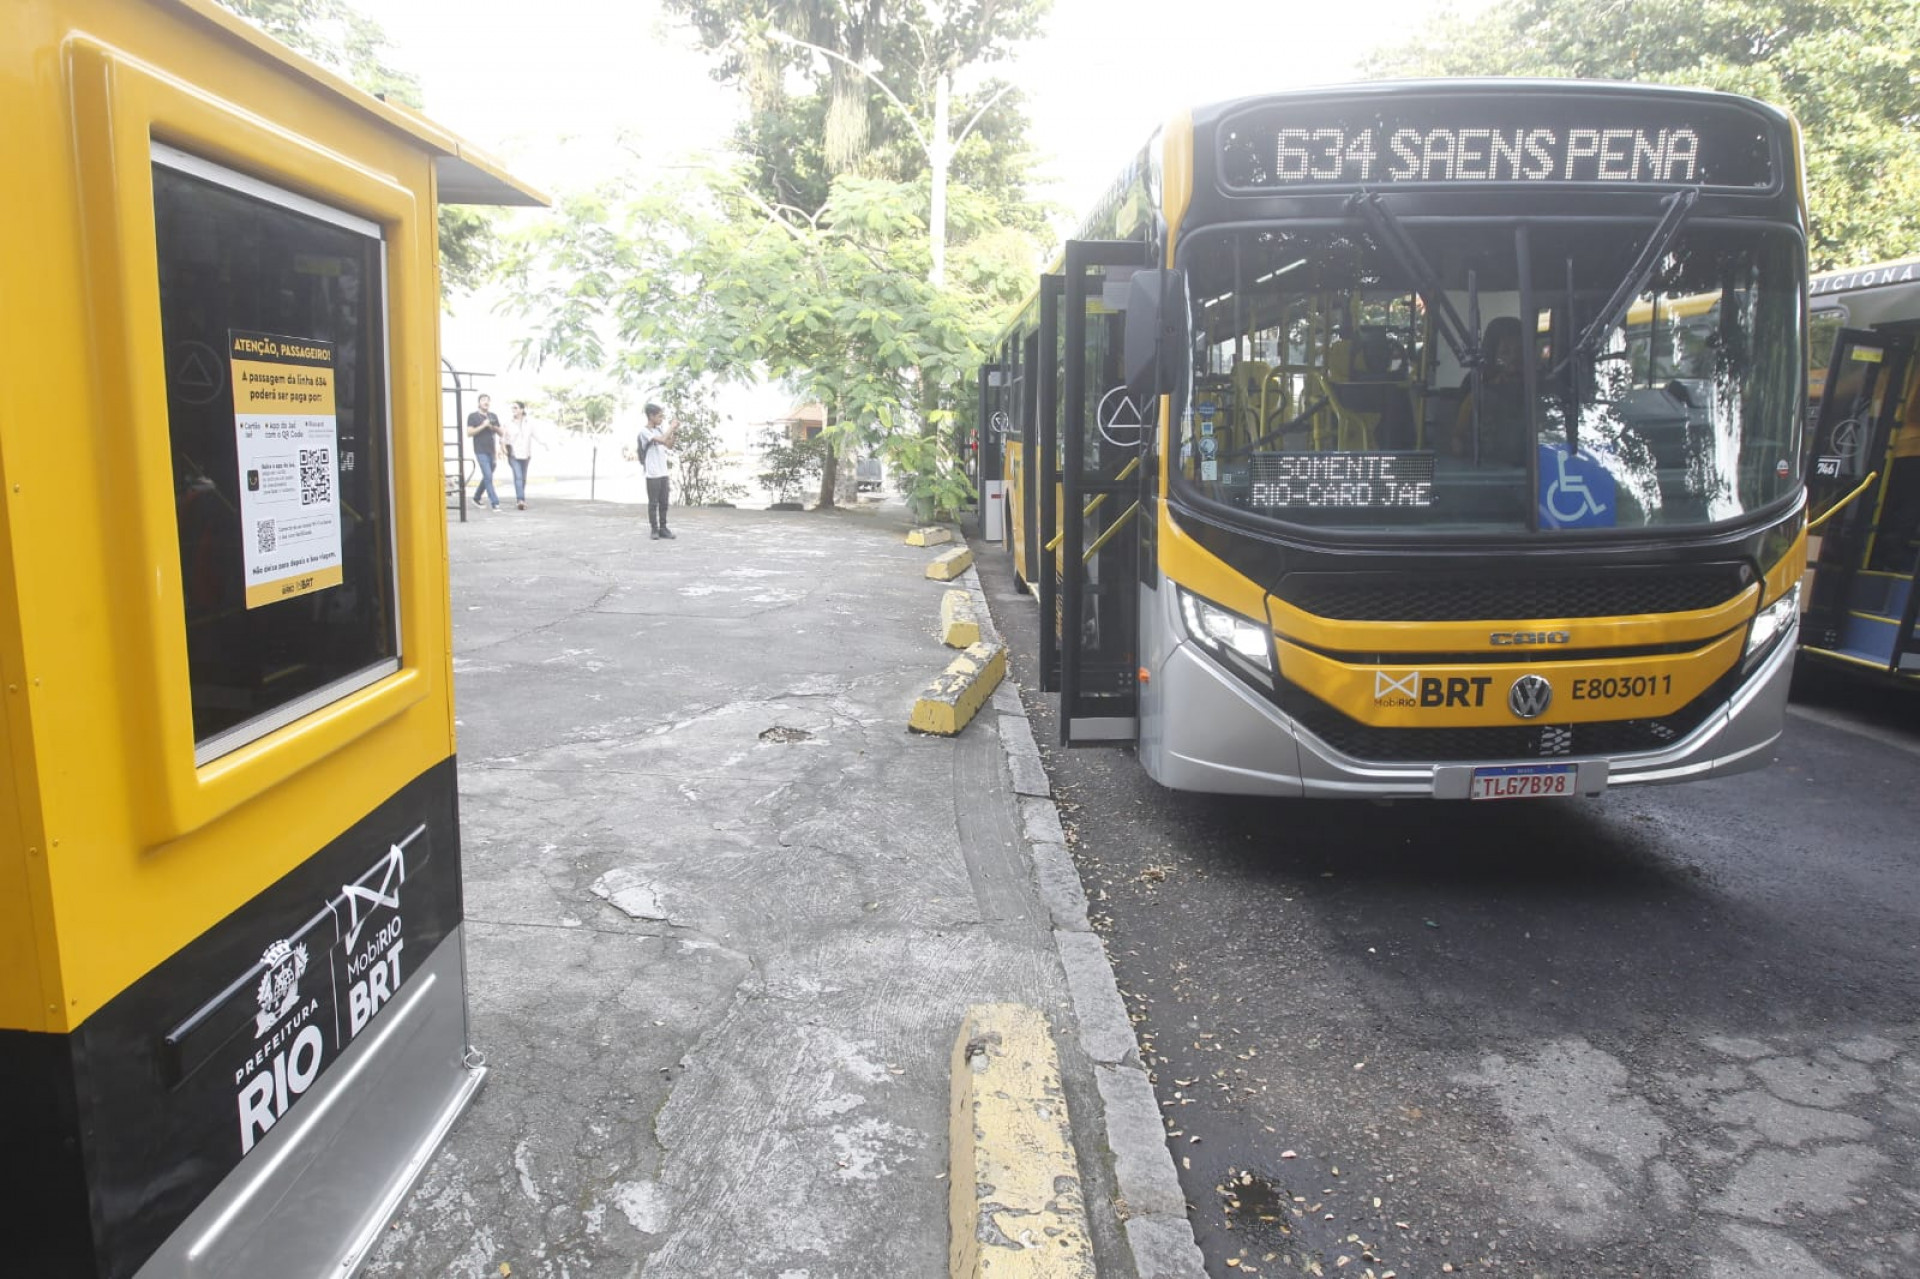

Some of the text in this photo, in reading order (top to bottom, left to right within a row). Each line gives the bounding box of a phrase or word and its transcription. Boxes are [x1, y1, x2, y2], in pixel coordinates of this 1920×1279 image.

[1276, 127, 1699, 182] 634 SAENS PENA
[234, 337, 331, 361] ATENÇÃO, PASSAGEIRO!
[242, 371, 248, 381] A
[249, 373, 286, 386] passagem
[287, 374, 296, 384] da
[297, 374, 314, 386] linha
[250, 388, 276, 402] poderá
[278, 391, 289, 400] ser
[290, 392, 307, 403] paga
[1279, 456, 1397, 480] SOMENTE
[1252, 482, 1431, 506] RIO-CARD JAE
[1420, 677, 1492, 708] BRT
[1571, 675, 1672, 701] E803011
[1482, 775, 1566, 798] TLG7B98
[348, 915, 402, 984] MobiRIO
[349, 938, 404, 1039] BRT
[235, 998, 319, 1086] PREFEITURA
[237, 1025, 323, 1156] RIO
